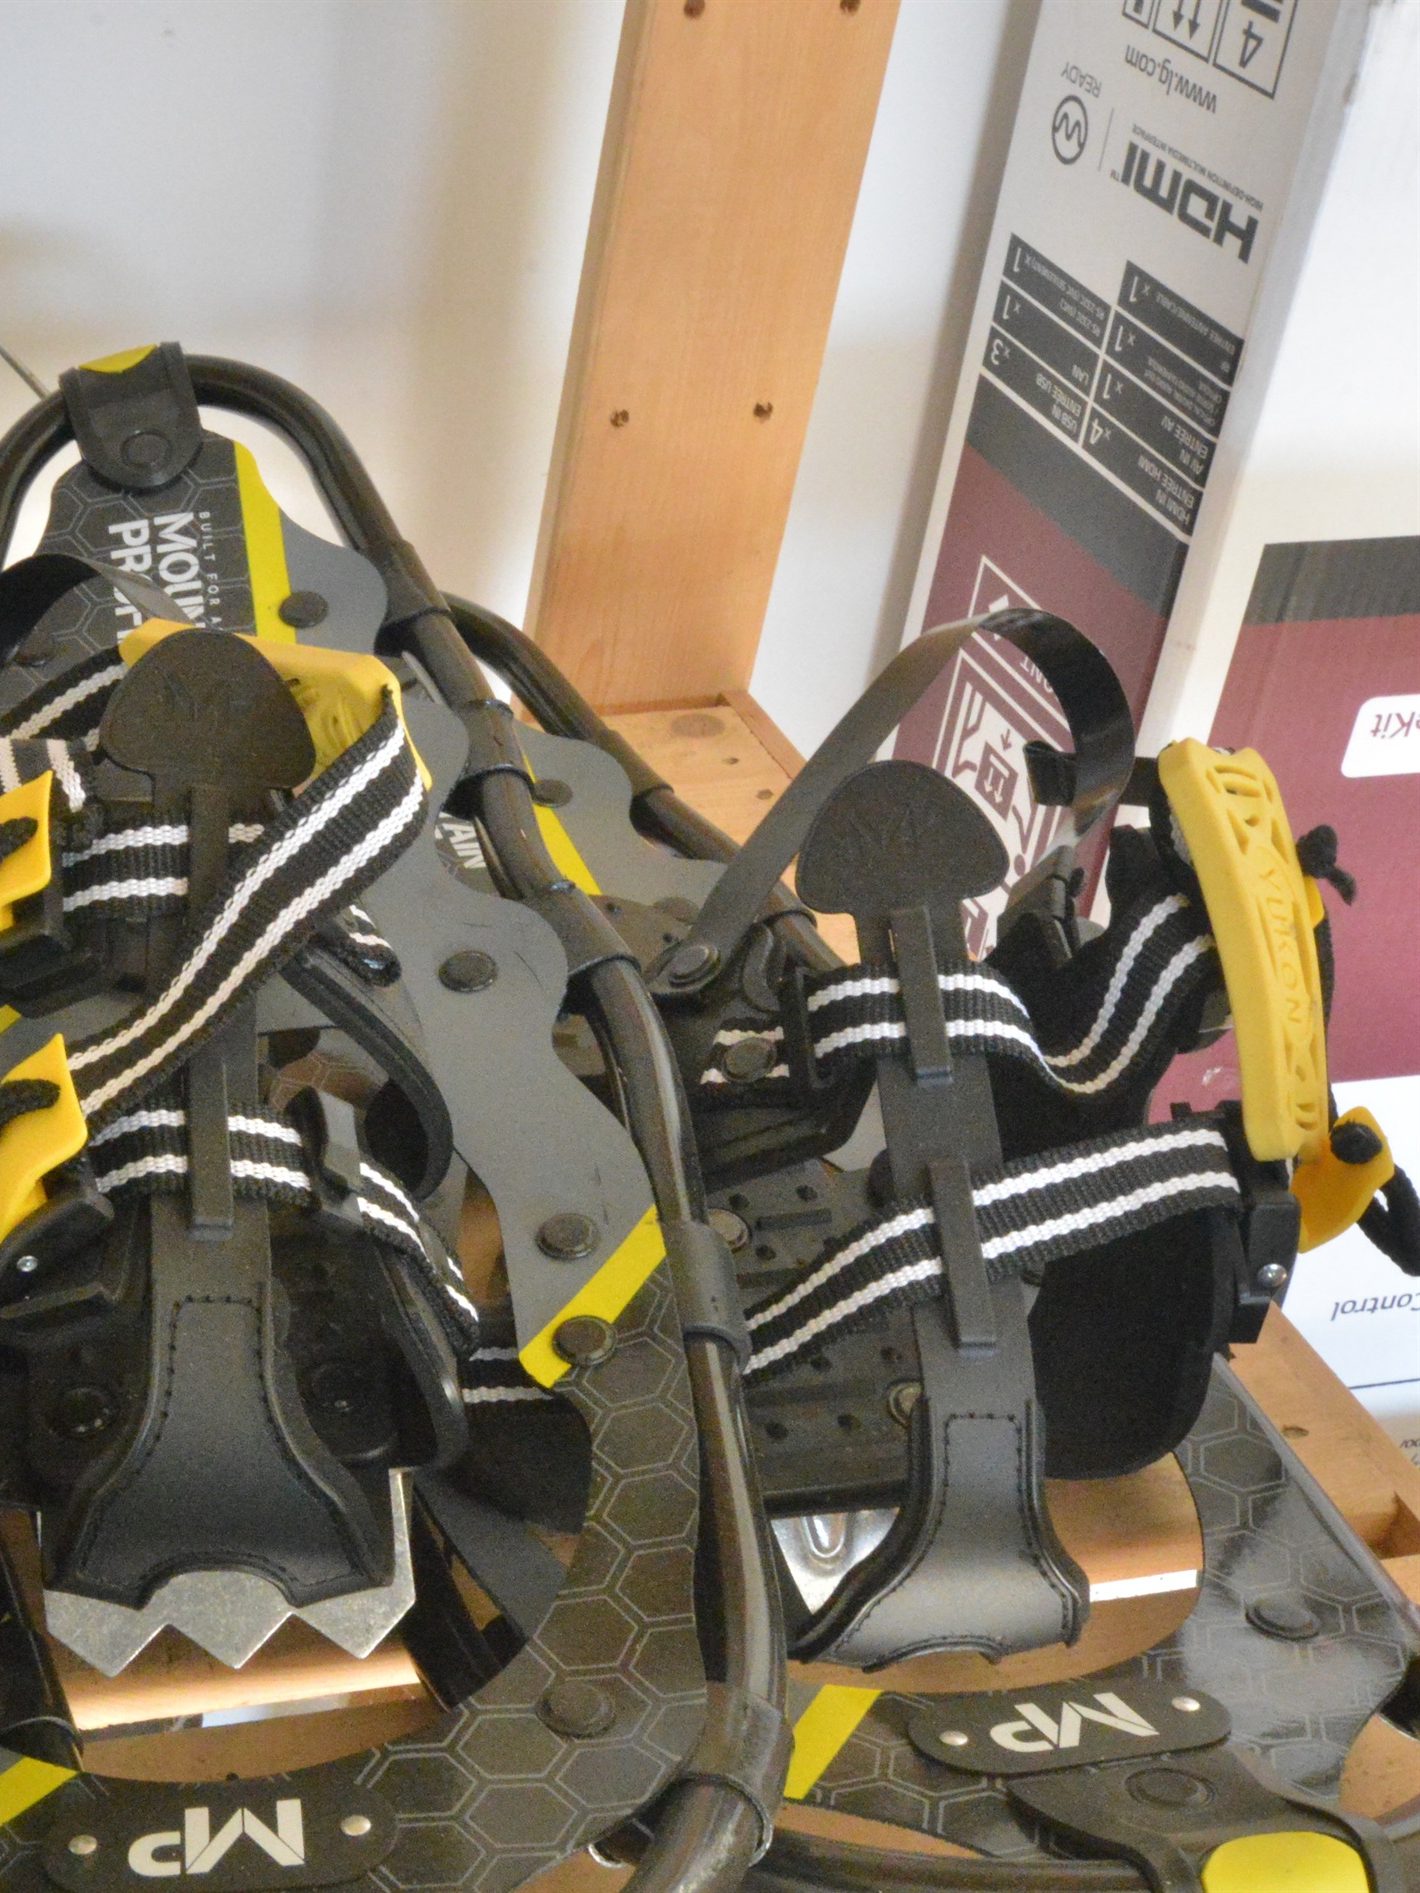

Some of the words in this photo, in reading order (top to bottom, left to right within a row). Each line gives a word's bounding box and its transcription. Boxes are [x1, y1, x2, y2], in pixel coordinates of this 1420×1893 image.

[1239, 21, 1263, 69] 4
[1060, 62, 1101, 98] READY
[1125, 44, 1216, 113] www.lg.com
[1131, 124, 1168, 154] INTERFACE
[1168, 147, 1207, 177] MULTIMEDIA
[1121, 140, 1259, 264] HDMI
[1037, 373, 1052, 393] USB
[1073, 364, 1089, 386] LAN
[1062, 413, 1077, 433] USB
[1162, 415, 1175, 433] AV
[1192, 459, 1204, 477] AV
[199, 512, 215, 561] BUILT
[207, 573, 220, 605] FOR
[1258, 868, 1302, 1024] YUKON
[990, 1692, 1161, 1755] MP
[127, 1797, 306, 1878] MP
